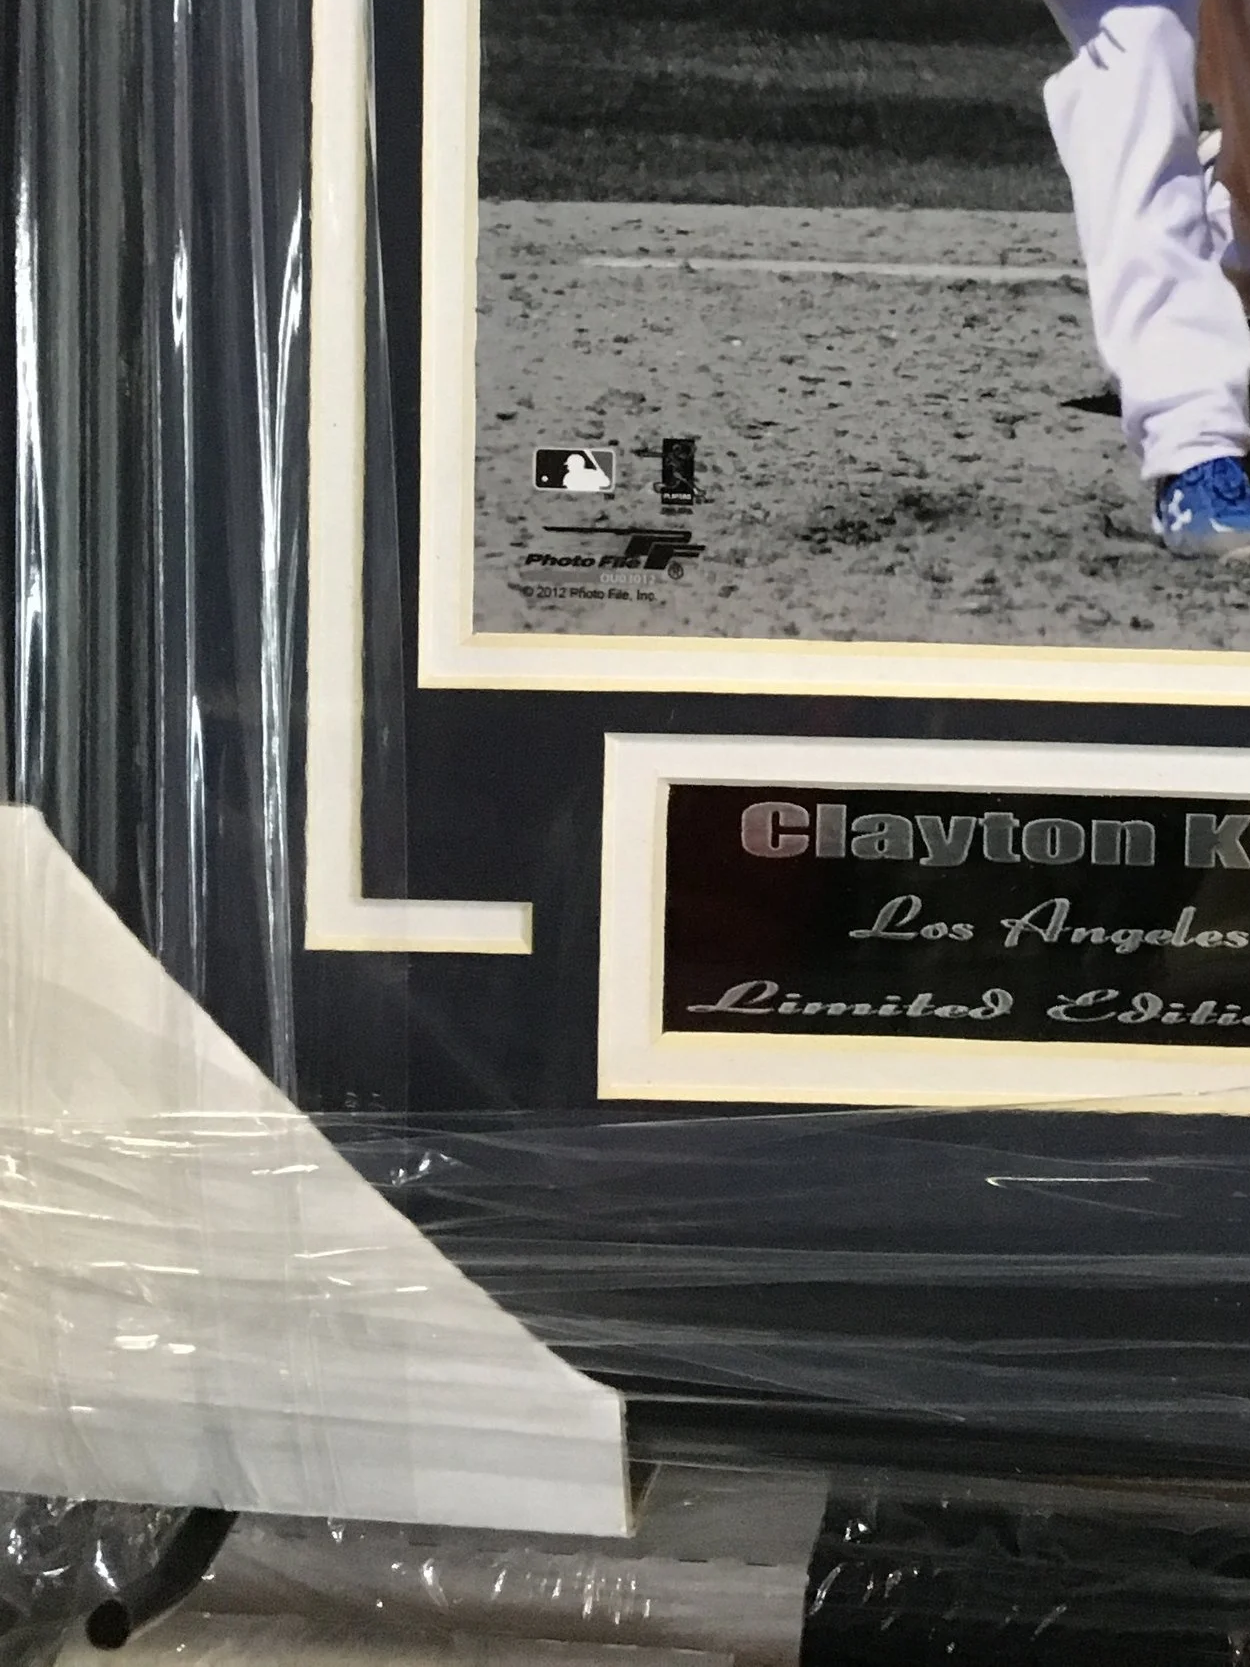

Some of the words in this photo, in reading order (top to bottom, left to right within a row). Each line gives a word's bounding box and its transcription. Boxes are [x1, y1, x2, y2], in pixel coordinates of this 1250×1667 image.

[524, 552, 598, 569] Photo
[598, 554, 642, 570] File
[537, 585, 567, 599] 2012
[570, 586, 605, 600] Photo
[740, 801, 1156, 867] Clayton
[848, 894, 975, 942] Los
[1000, 897, 1250, 954] Angeles
[686, 979, 1014, 1021] Limited
